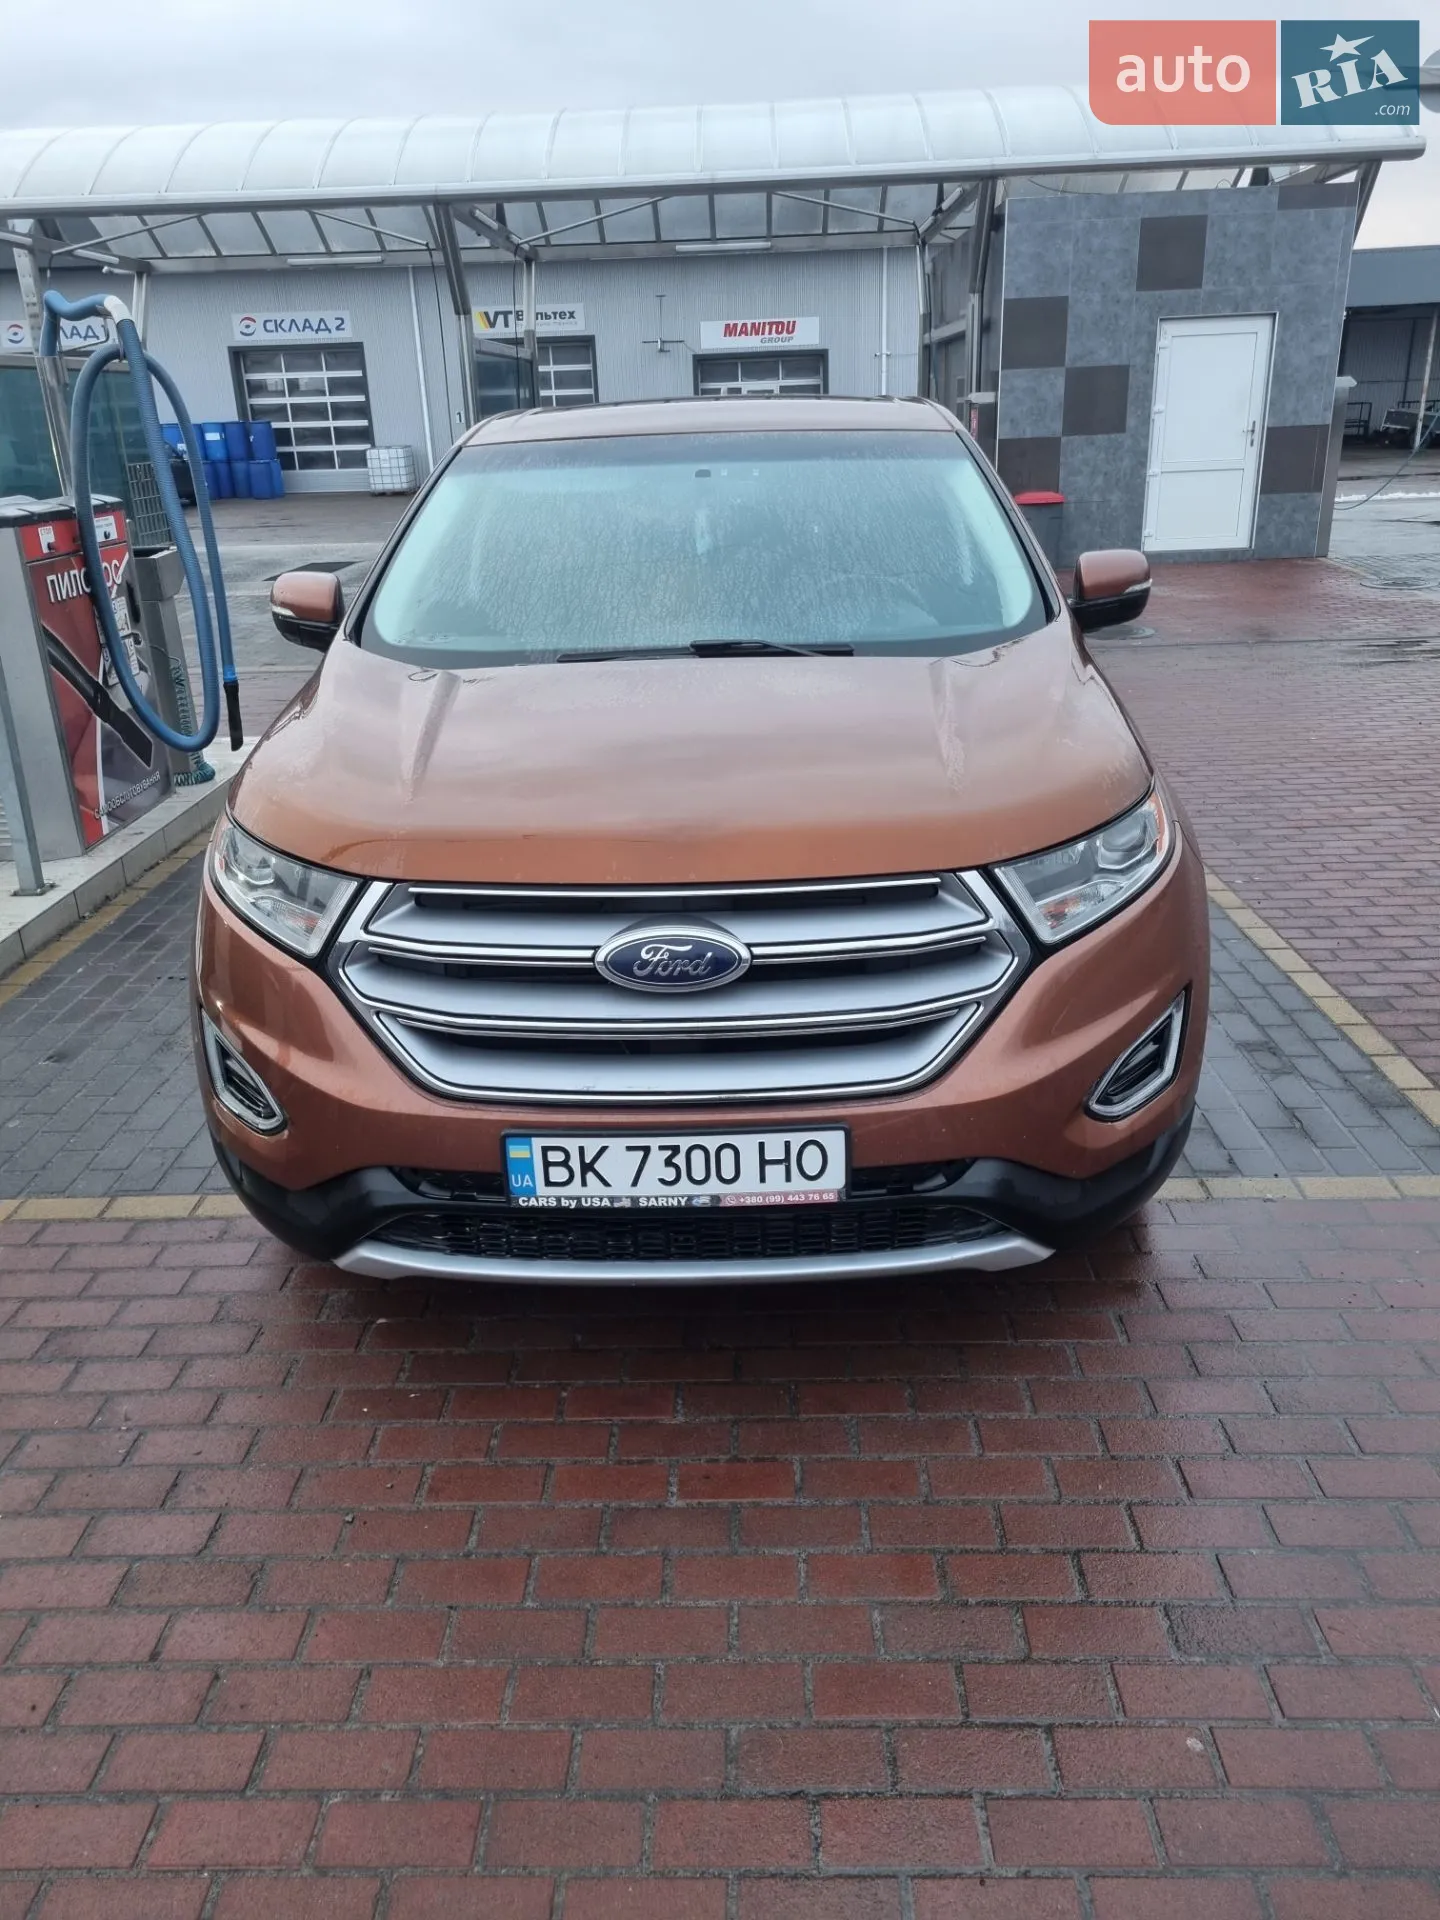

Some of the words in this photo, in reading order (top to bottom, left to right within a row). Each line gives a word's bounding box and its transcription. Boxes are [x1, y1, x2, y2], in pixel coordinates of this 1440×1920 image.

[484, 310, 513, 329] VT
[515, 310, 576, 321] Вльтех
[60, 324, 100, 341] ЛАД
[263, 317, 332, 334] СКЛАД
[334, 317, 346, 331] 2
[723, 320, 797, 337] MANITOU
[760, 336, 794, 344] GROUP
[456, 411, 462, 423] 1
[46, 559, 122, 604] ПИЛООС
[632, 943, 713, 977] Ford
[540, 1144, 612, 1188] BK
[625, 1142, 741, 1188] 7300
[758, 1138, 829, 1184] HO
[511, 1174, 534, 1188] UA
[518, 1196, 557, 1207] CARS
[561, 1196, 578, 1209] by
[581, 1196, 611, 1207] USA
[638, 1196, 688, 1207] SARNY
[740, 1195, 763, 1203] +380
[765, 1194, 785, 1204] (99)
[787, 1193, 805, 1202] 443
[808, 1193, 820, 1201] 76
[822, 1192, 835, 1200] 65
